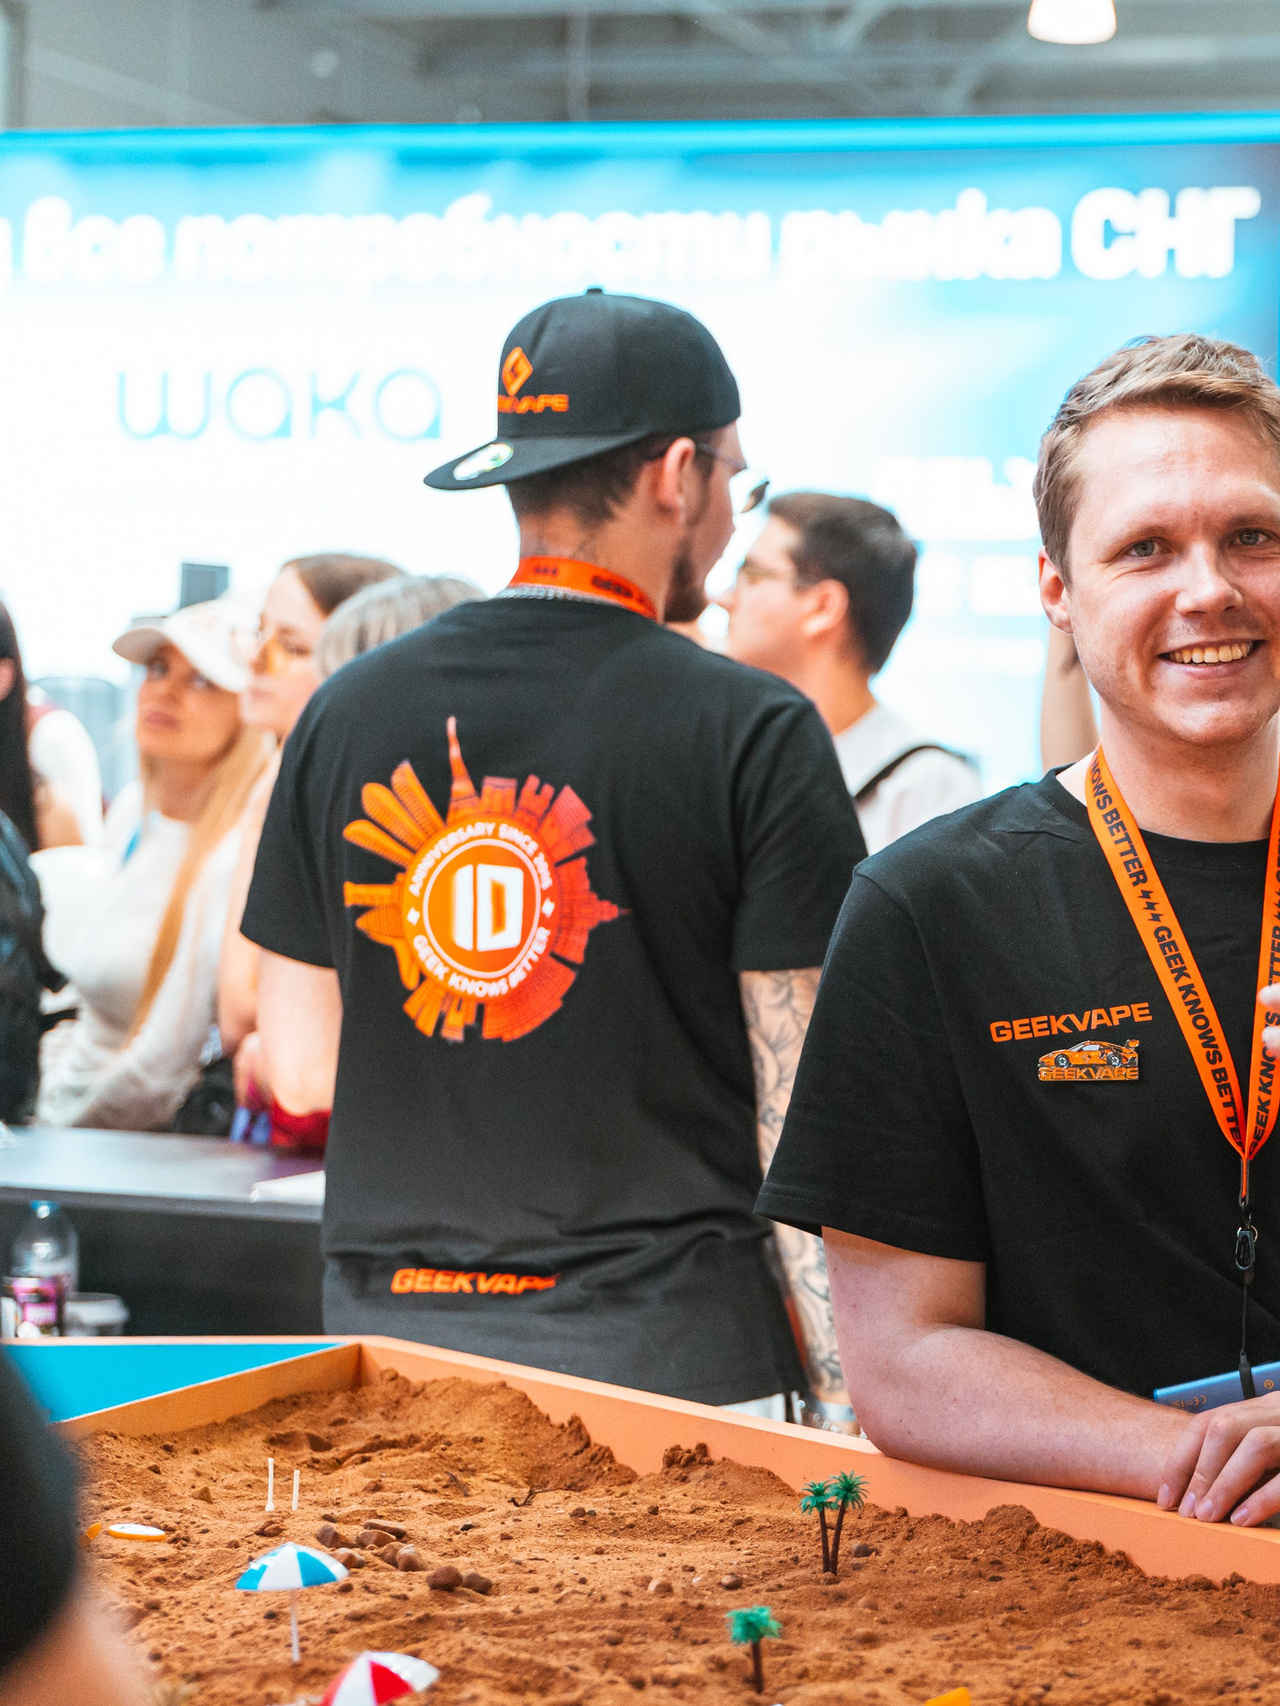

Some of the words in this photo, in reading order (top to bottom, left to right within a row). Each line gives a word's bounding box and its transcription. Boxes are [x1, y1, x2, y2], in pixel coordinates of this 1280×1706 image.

[1072, 188, 1261, 279] СНГ
[409, 822, 496, 897] ANNIVERSARY
[498, 823, 539, 857] SINCE
[453, 863, 525, 953] ID
[1091, 752, 1113, 810] NOWS
[1103, 808, 1148, 887] BETTER
[1154, 926, 1190, 983] GEEK
[1178, 983, 1222, 1066] KNOWS
[413, 935, 449, 980] GEEK
[448, 972, 508, 998] KNOWS
[508, 927, 551, 989] BETTER
[989, 1002, 1153, 1043] GEEKVAPE
[1038, 1067, 1139, 1081] GEEKVAPE
